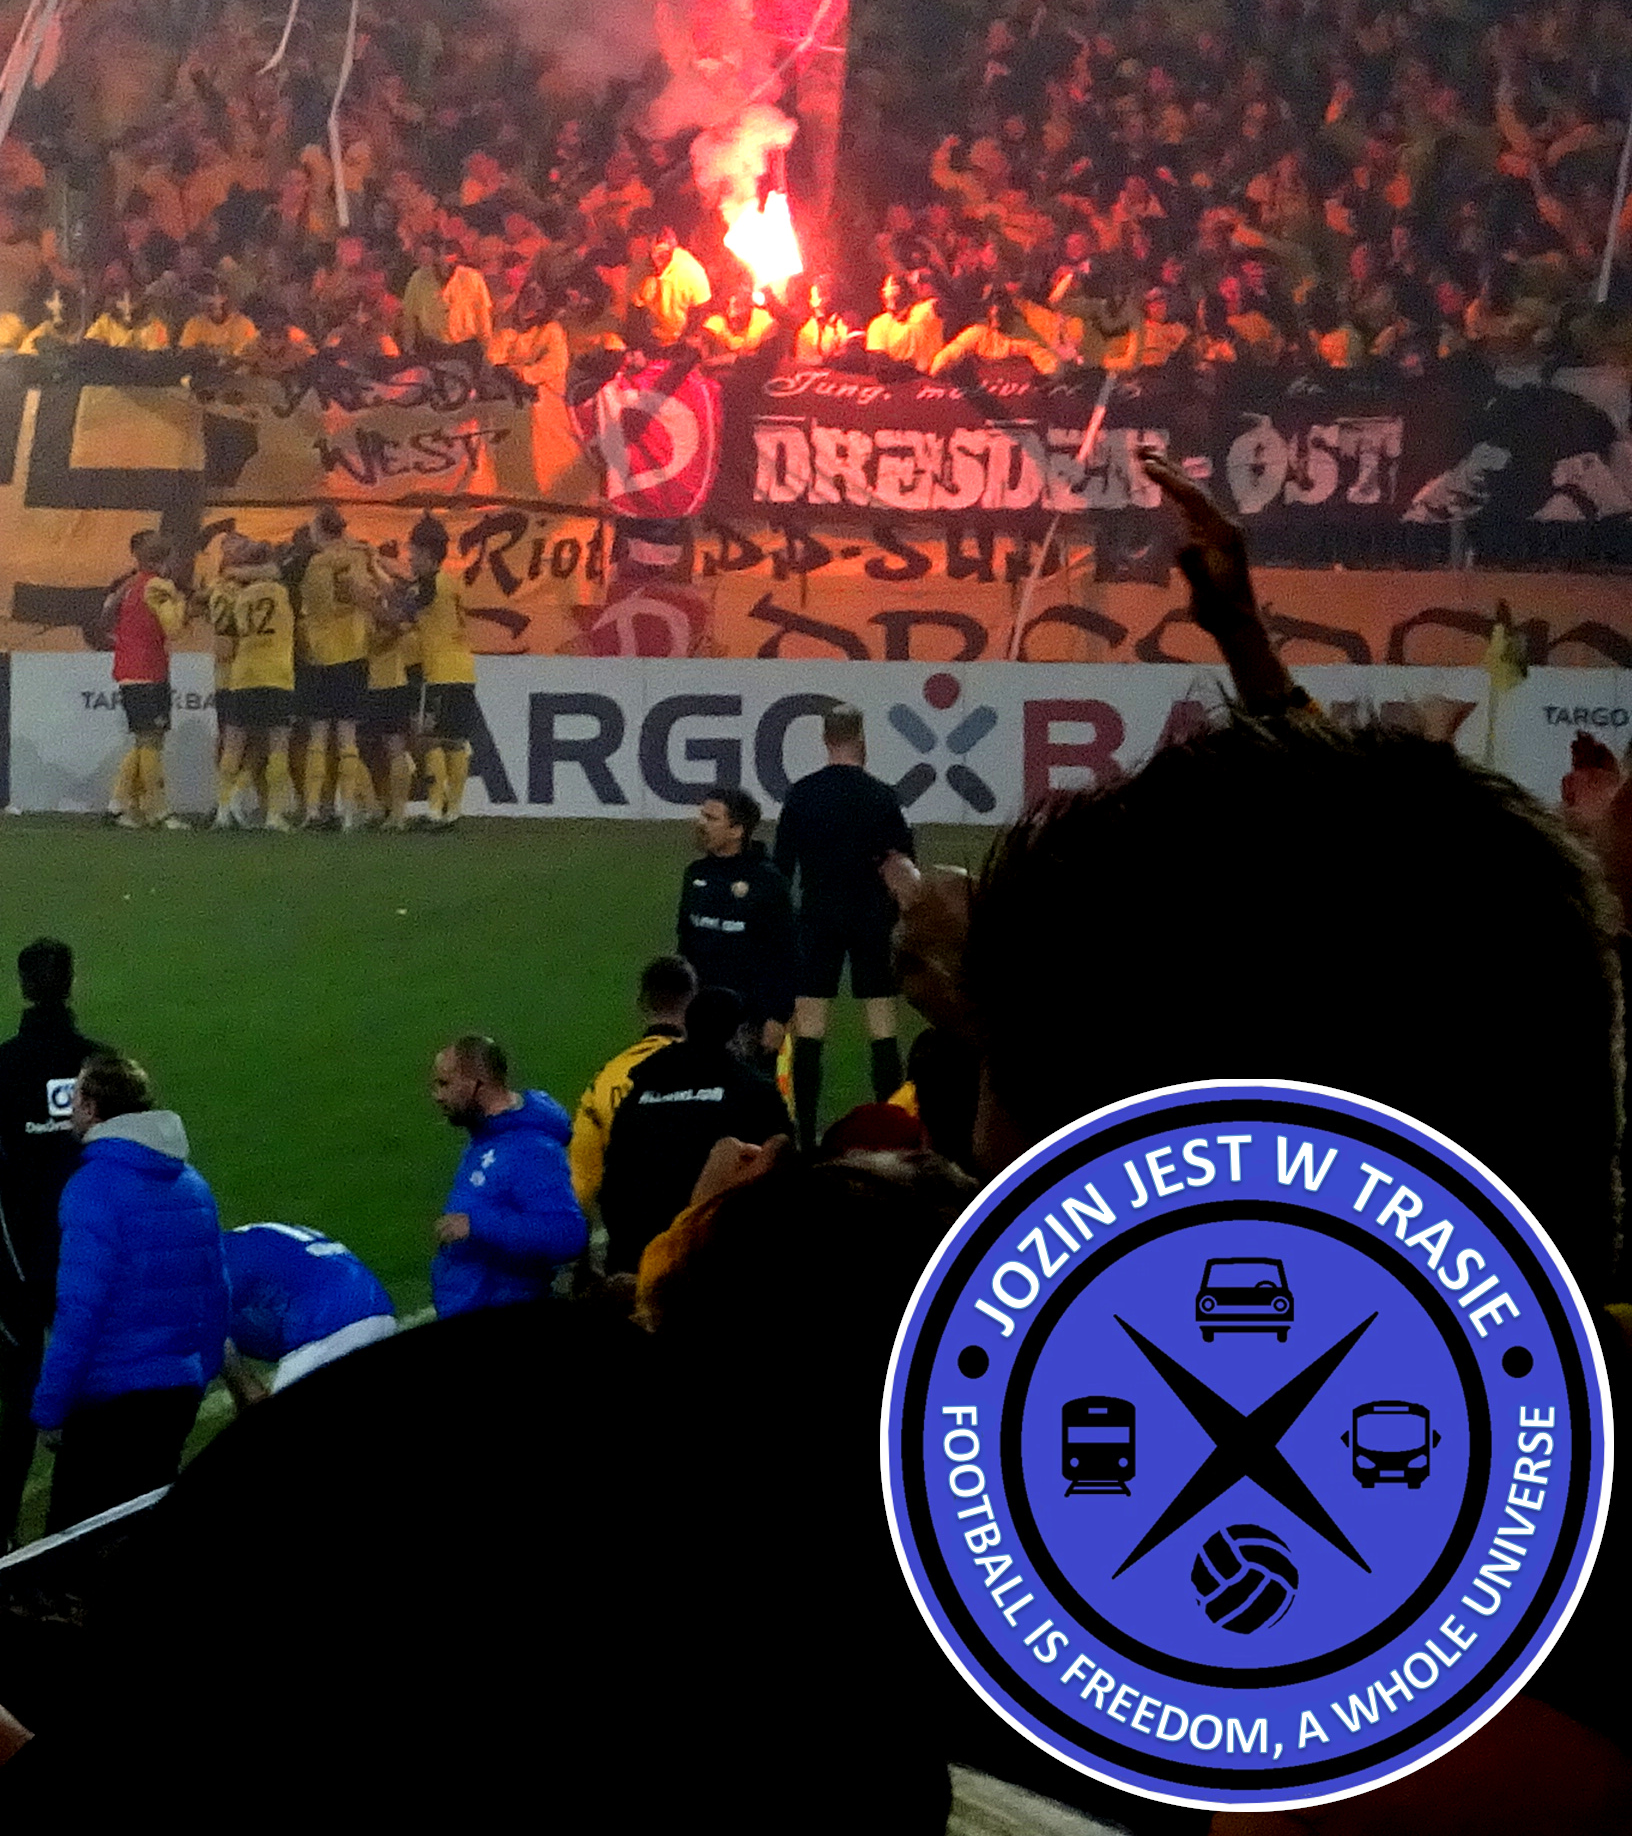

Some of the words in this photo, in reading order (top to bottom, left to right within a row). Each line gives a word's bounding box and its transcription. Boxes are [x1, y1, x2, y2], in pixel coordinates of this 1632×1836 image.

[313, 426, 511, 486] WEST
[458, 511, 613, 597] Riot
[414, 688, 866, 808] ARGO
[1542, 705, 1630, 728] TARGO
